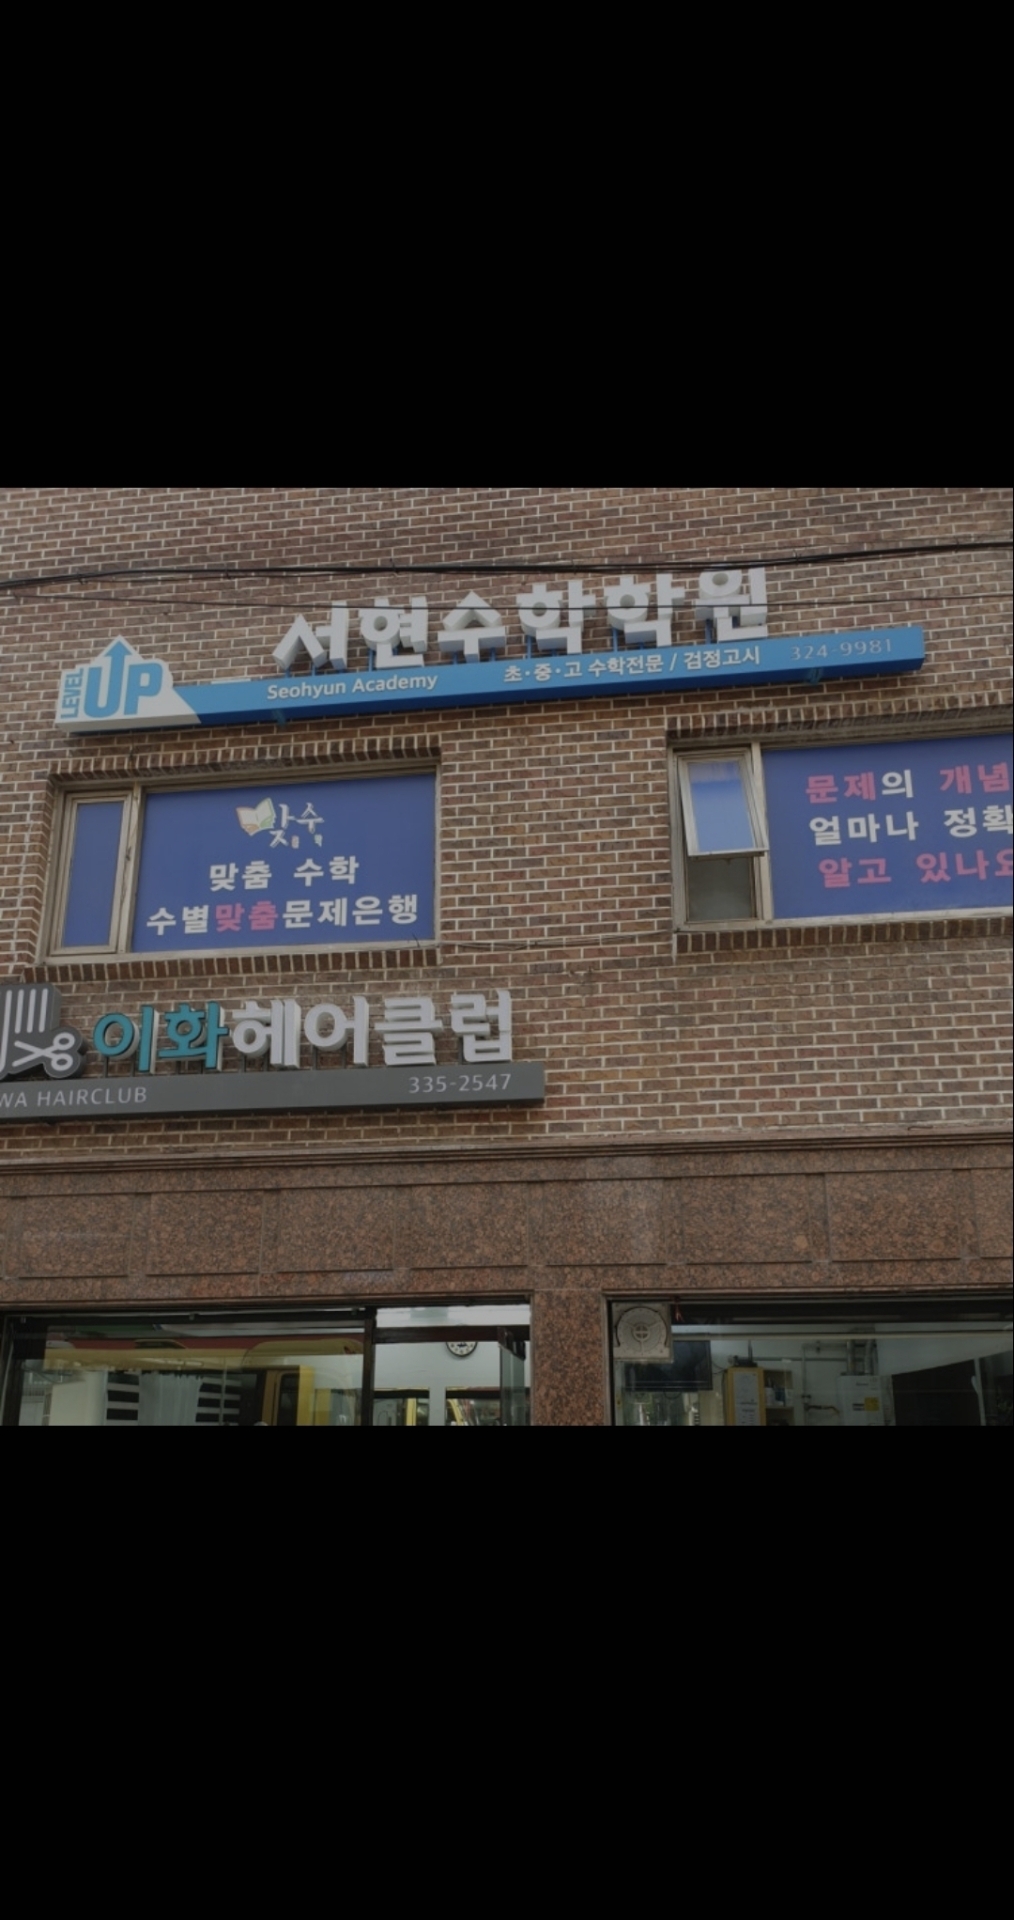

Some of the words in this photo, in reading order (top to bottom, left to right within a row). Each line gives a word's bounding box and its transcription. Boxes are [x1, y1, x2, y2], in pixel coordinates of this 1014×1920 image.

[272, 567, 768, 670] 서현수학학원
[588, 654, 664, 675] 수학전문
[684, 645, 760, 669] 검정고시
[790, 638, 892, 660] 324-9981
[60, 667, 84, 719] LEVEL
[84, 641, 163, 718] UP
[267, 681, 346, 700] Seohyun
[352, 674, 438, 693] Academy
[805, 769, 914, 804] 문제의
[940, 762, 1010, 794] 개념
[809, 811, 919, 846] 얼마나
[943, 804, 1013, 838] 정확
[209, 860, 273, 892] 맞춤
[293, 855, 360, 887] 수학
[818, 857, 892, 888] 알고
[146, 893, 419, 936] 수별맞춤문제은행
[93, 990, 513, 1073] 이화헤어클럽
[36, 1086, 147, 1107] HAIRCLUB
[408, 1074, 512, 1094] 335-2547
